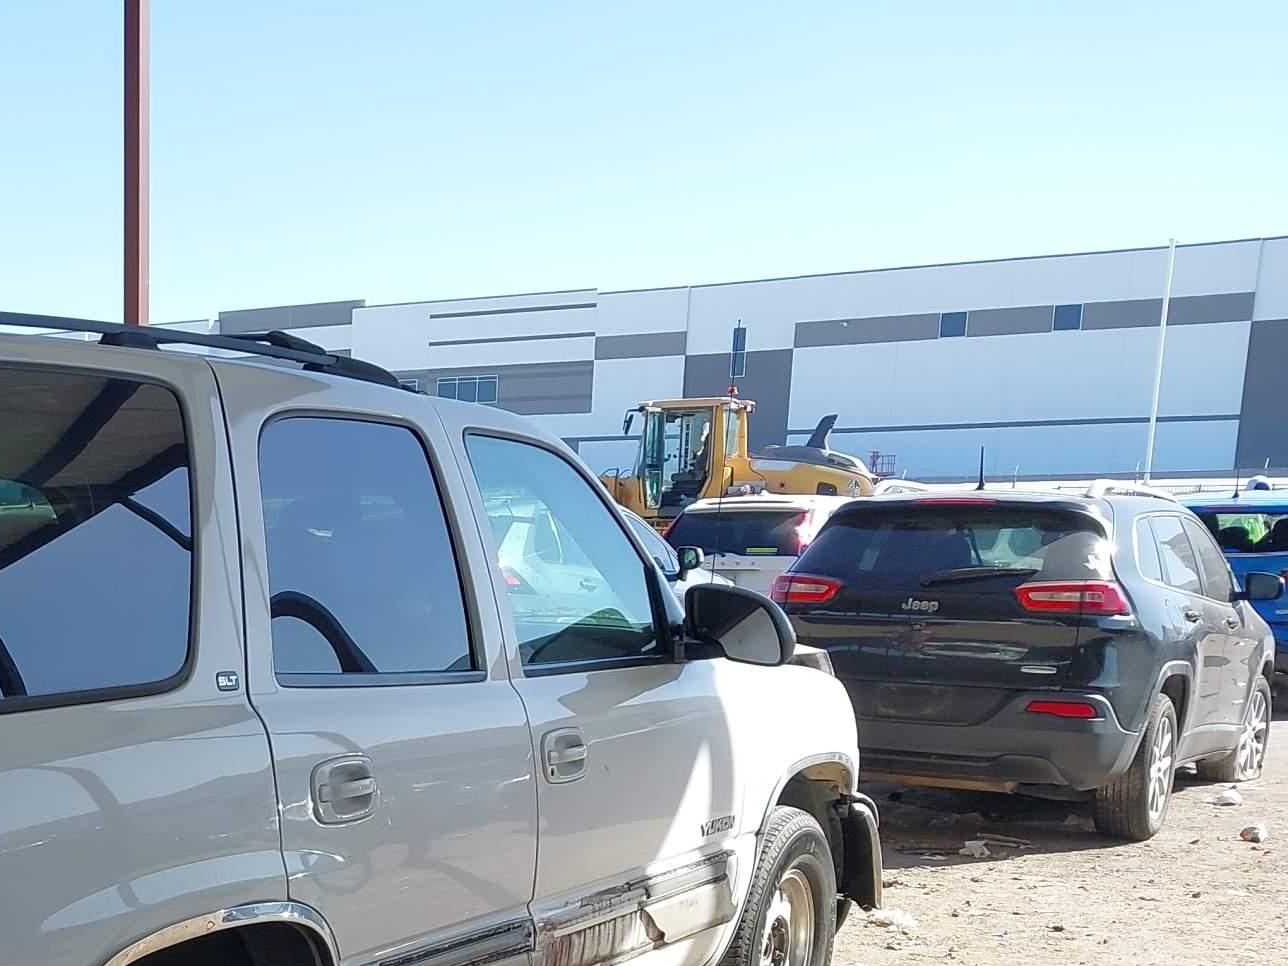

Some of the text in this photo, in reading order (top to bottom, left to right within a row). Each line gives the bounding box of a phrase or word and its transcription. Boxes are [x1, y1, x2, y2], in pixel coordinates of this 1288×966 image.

[901, 597, 939, 613] Jeep
[218, 675, 237, 686] SLT
[700, 814, 736, 837] YUKON
